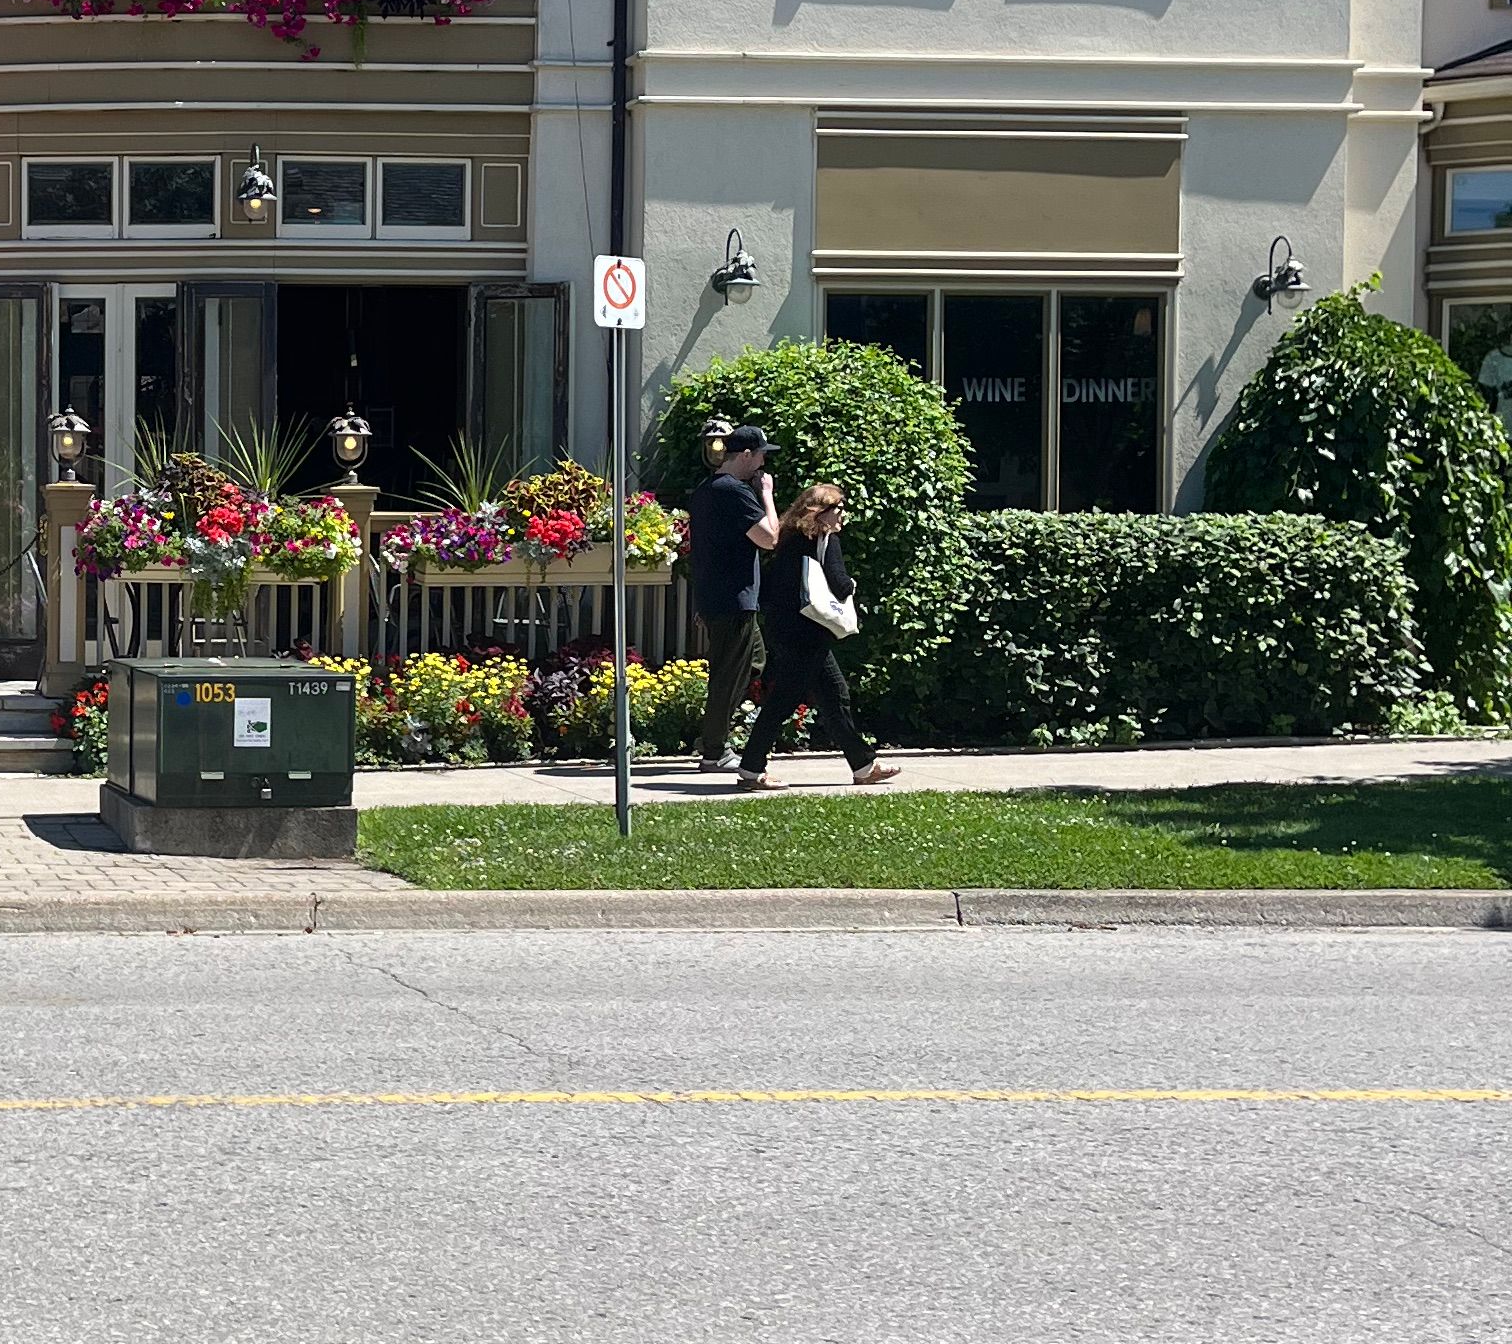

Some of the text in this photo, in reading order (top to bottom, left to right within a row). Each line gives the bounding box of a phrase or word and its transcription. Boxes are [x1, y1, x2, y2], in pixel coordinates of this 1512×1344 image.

[962, 377, 1156, 403] WINE DINNER
[194, 682, 236, 702] 1053
[288, 681, 329, 695] T1439
